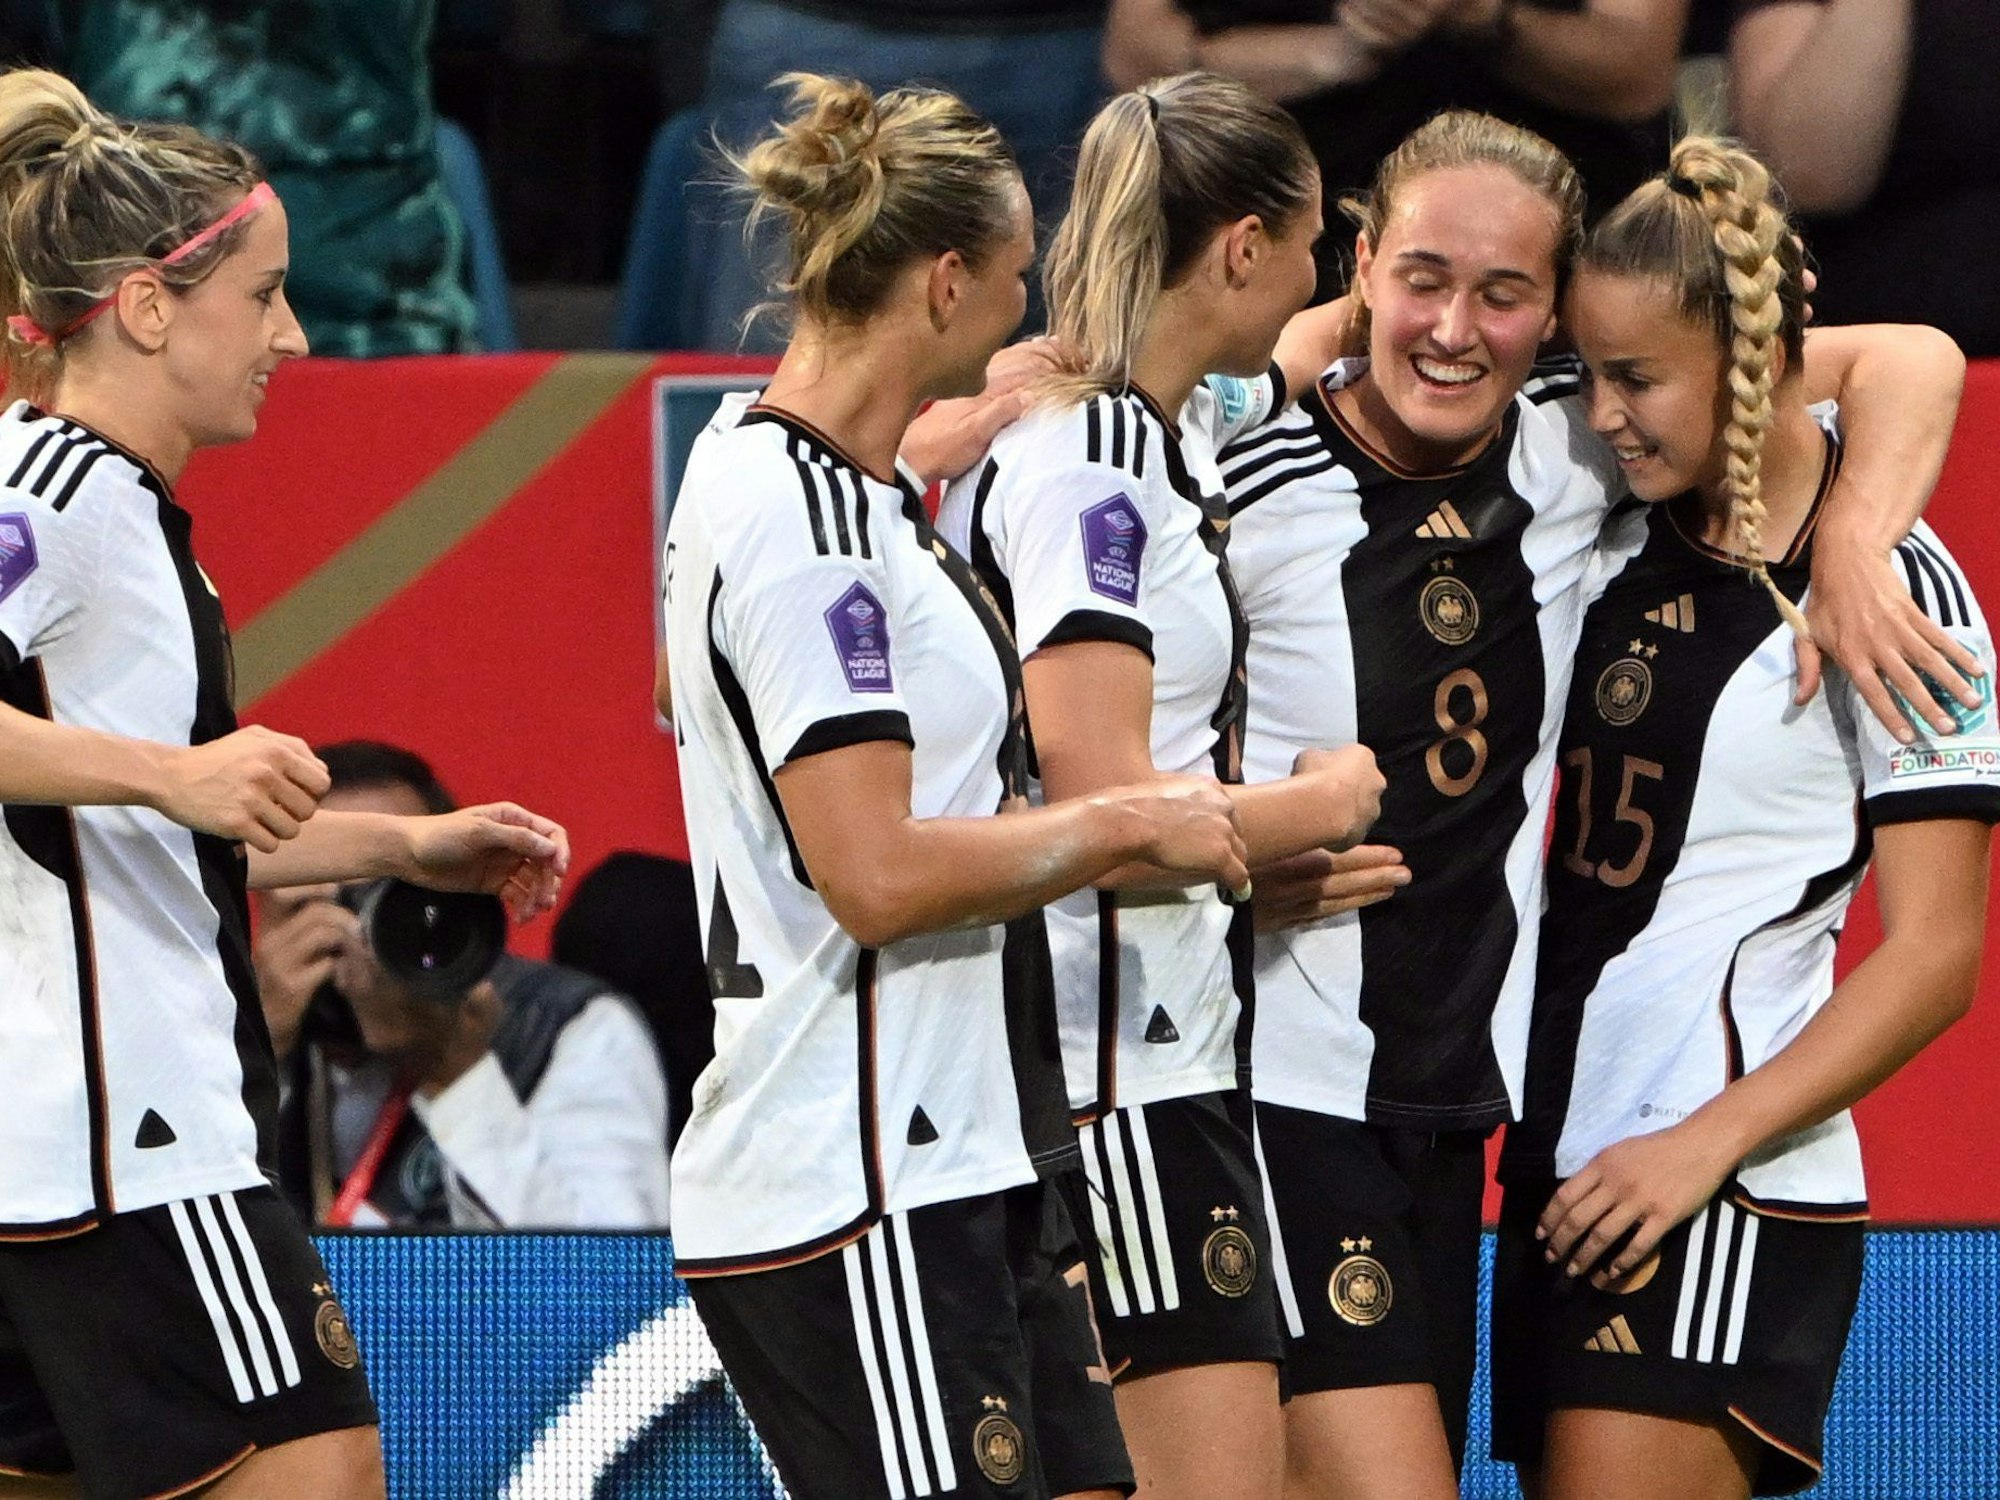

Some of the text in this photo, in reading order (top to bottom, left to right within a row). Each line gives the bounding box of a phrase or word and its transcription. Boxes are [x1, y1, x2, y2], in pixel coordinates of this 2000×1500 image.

[1093, 562, 1136, 585] NATIONS
[1095, 572, 1133, 593] LEAGUE
[847, 658, 887, 669] NATIONS
[851, 668, 888, 680] LEAGUE
[1425, 667, 1489, 797] 8
[1563, 746, 1665, 888] 15
